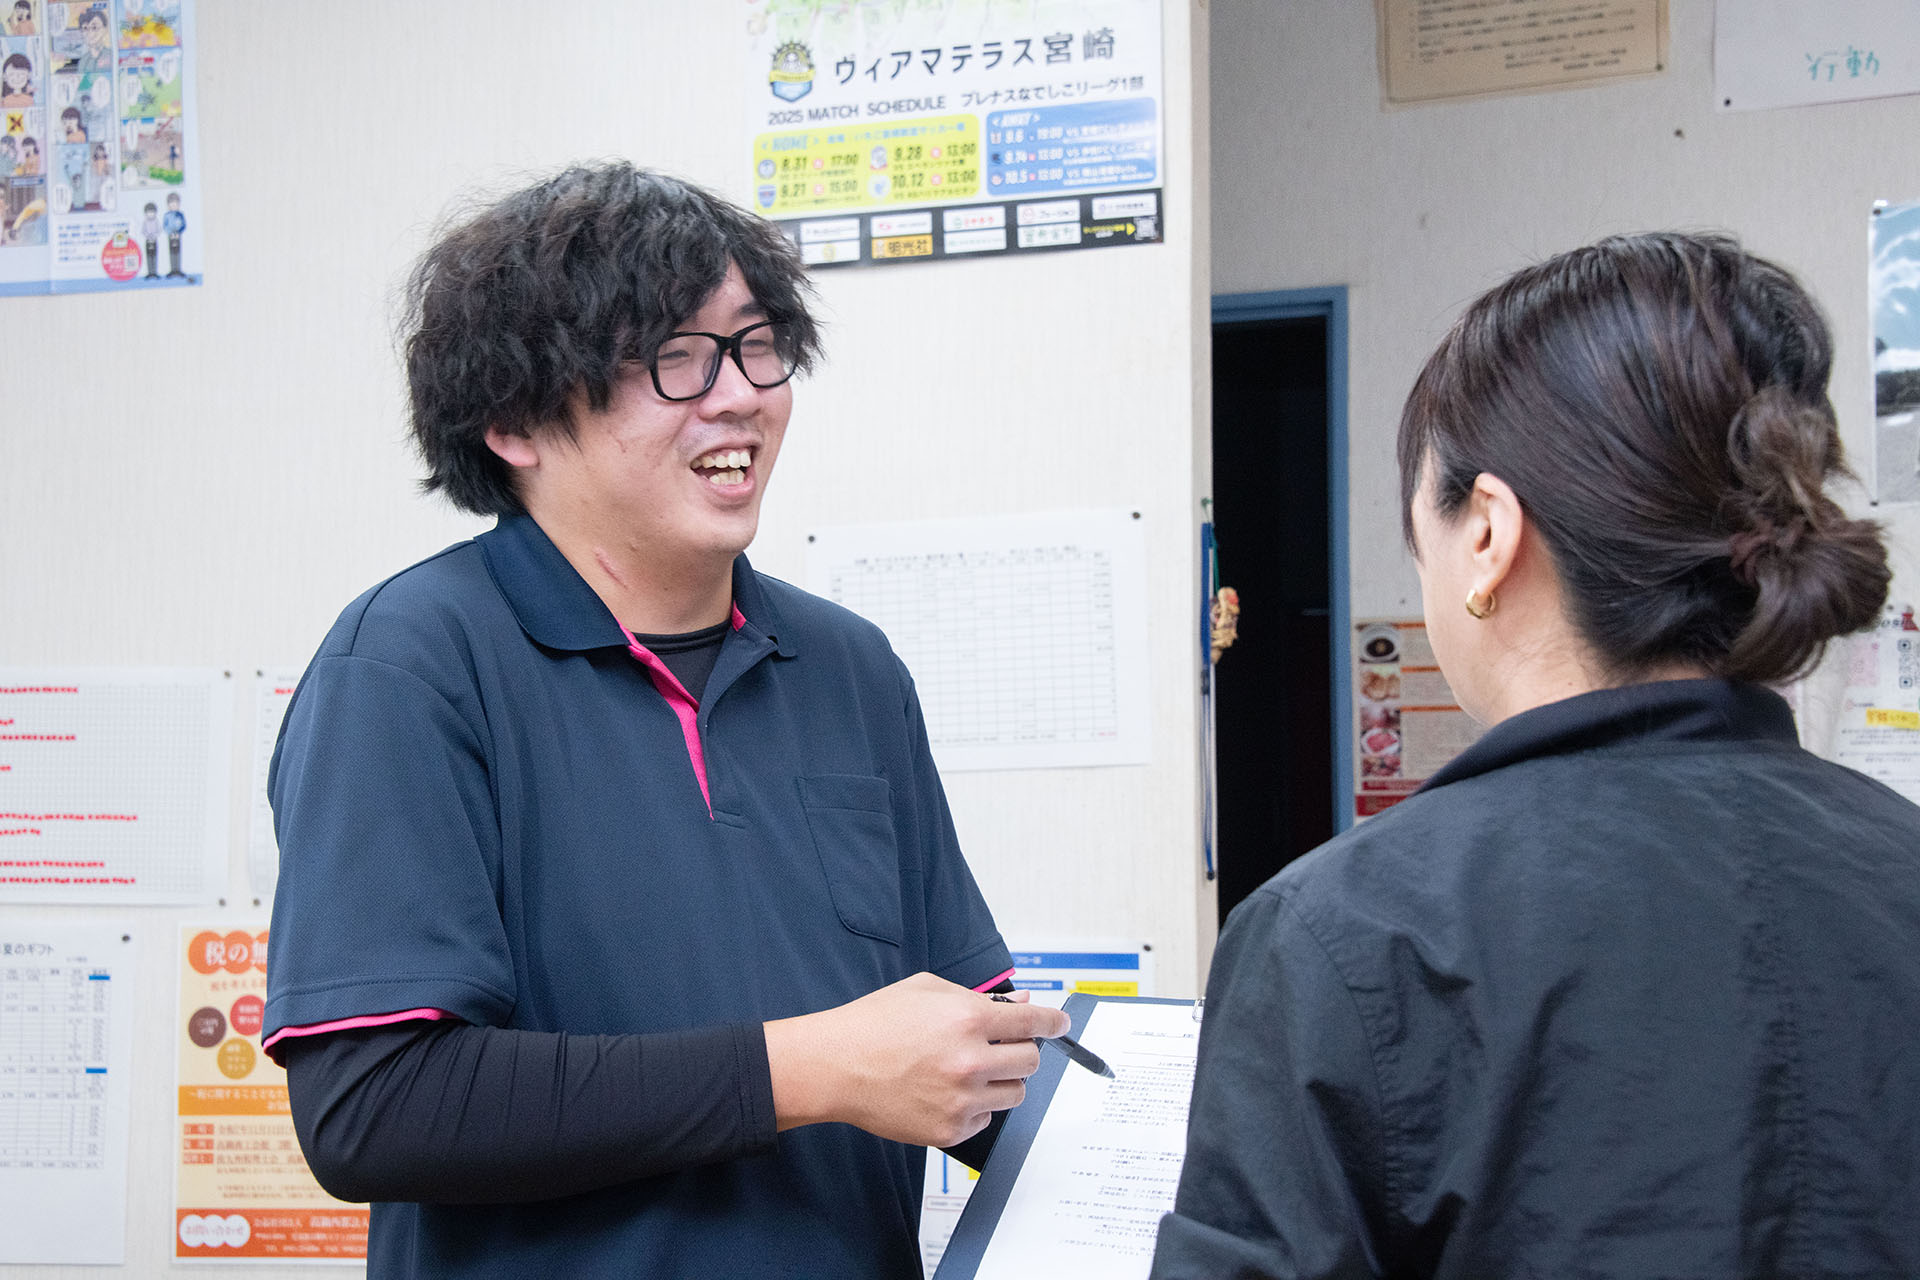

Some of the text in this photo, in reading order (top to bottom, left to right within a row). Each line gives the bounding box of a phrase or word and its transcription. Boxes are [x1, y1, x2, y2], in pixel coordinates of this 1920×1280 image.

[835, 27, 1115, 85] ヴィアマテラス宮崎
[1805, 44, 1880, 82] 行動
[961, 76, 1144, 107] プレナスなでしこリーグ1部
[769, 95, 946, 126] 2025 MATCH SCHEDULE
